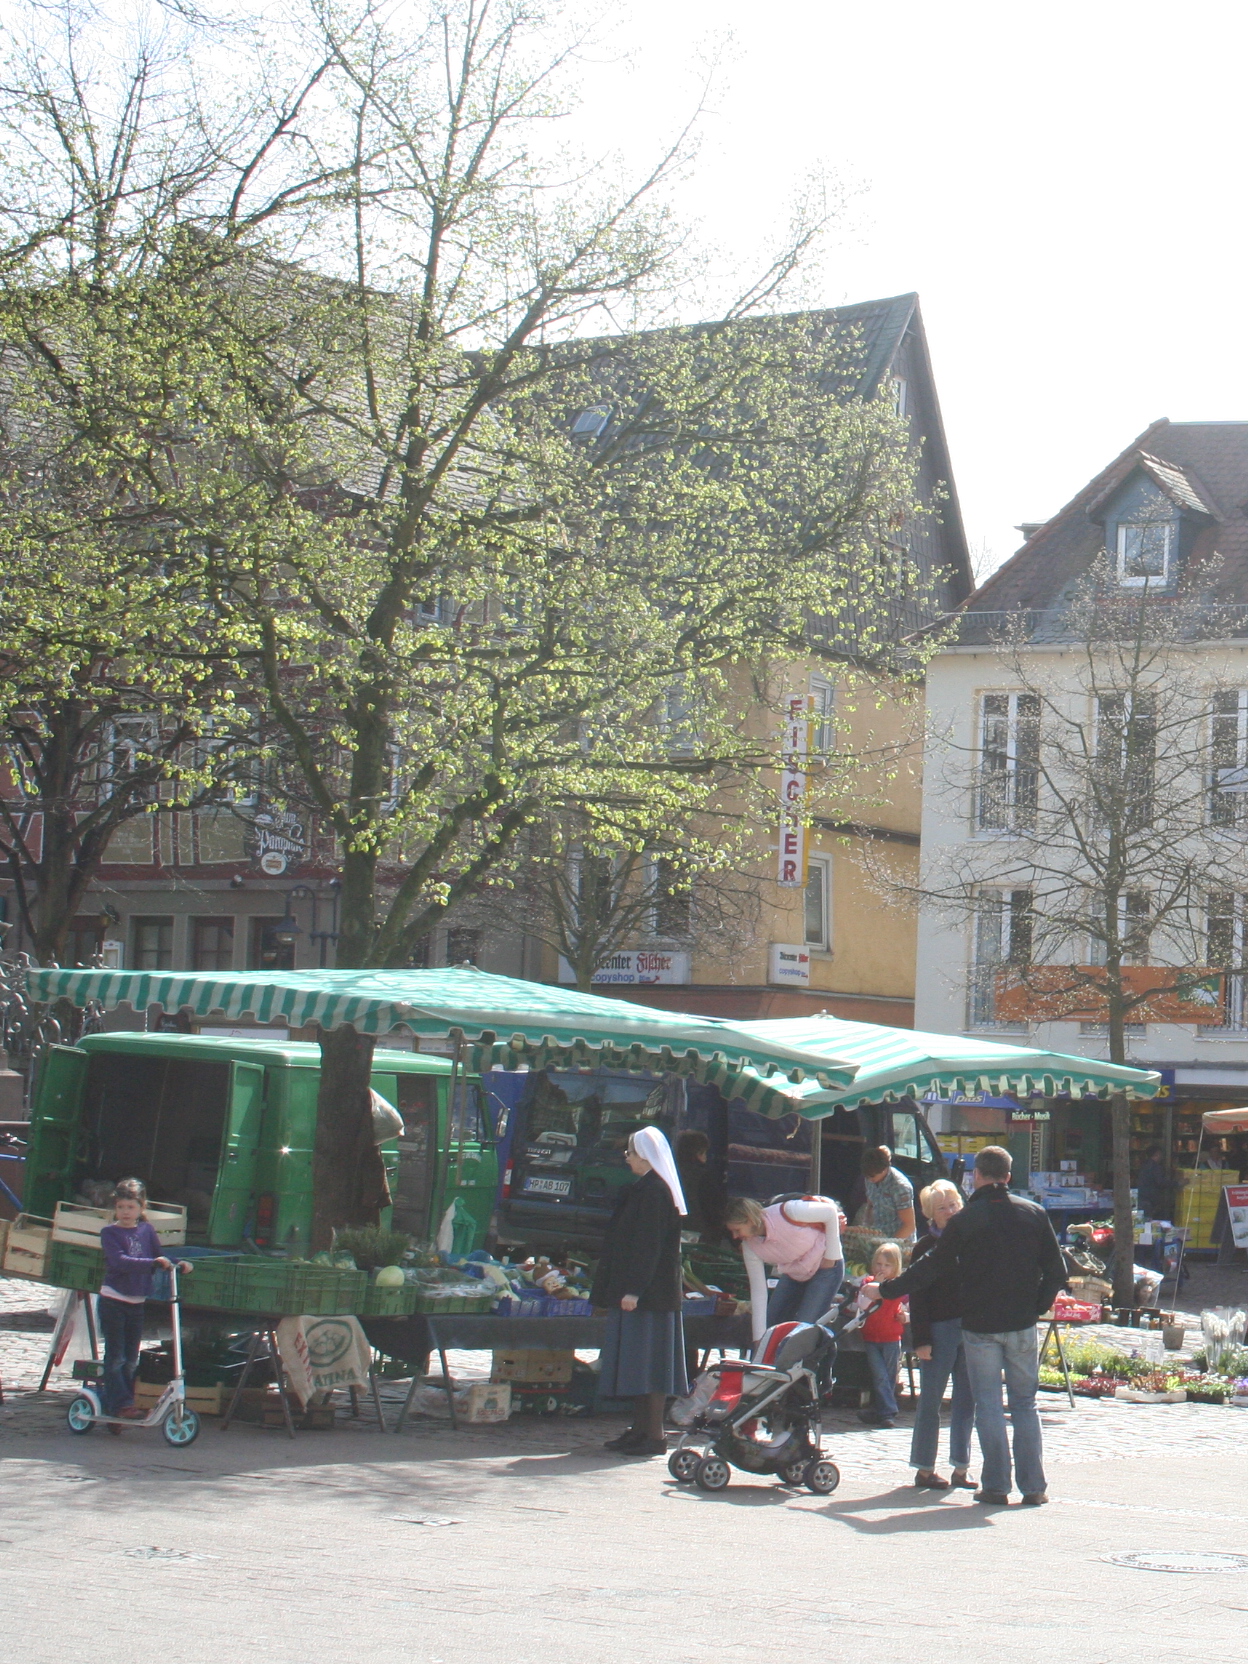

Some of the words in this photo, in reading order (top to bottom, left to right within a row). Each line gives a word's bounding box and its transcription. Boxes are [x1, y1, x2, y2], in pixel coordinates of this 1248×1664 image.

[636, 952, 671, 974] Fischer
[590, 972, 635, 983] copyshop
[529, 1180, 540, 1189] HP
[543, 1181, 554, 1190] AB
[554, 1182, 570, 1192] 107
[313, 1366, 357, 1387] ATINA
